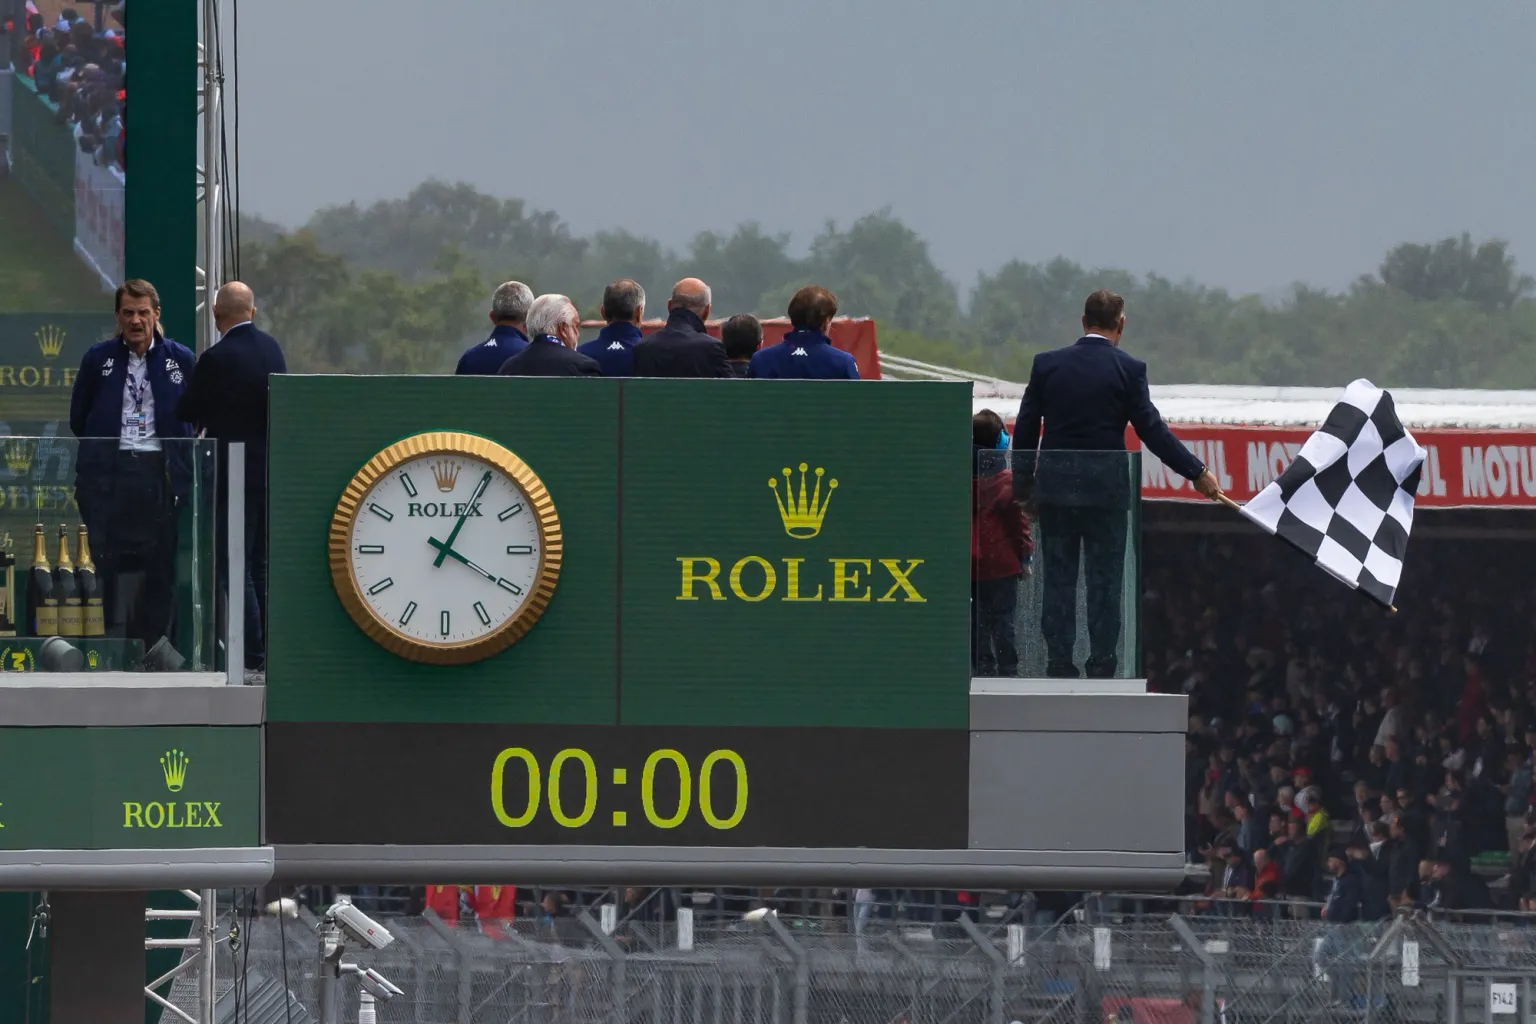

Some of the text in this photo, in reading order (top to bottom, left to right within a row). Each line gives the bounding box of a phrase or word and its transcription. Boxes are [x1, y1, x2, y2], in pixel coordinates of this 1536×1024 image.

[408, 503, 483, 517] ROLEX
[675, 555, 928, 604] ROLEX
[491, 748, 750, 831] 00:00
[123, 801, 223, 829] ROLEX
